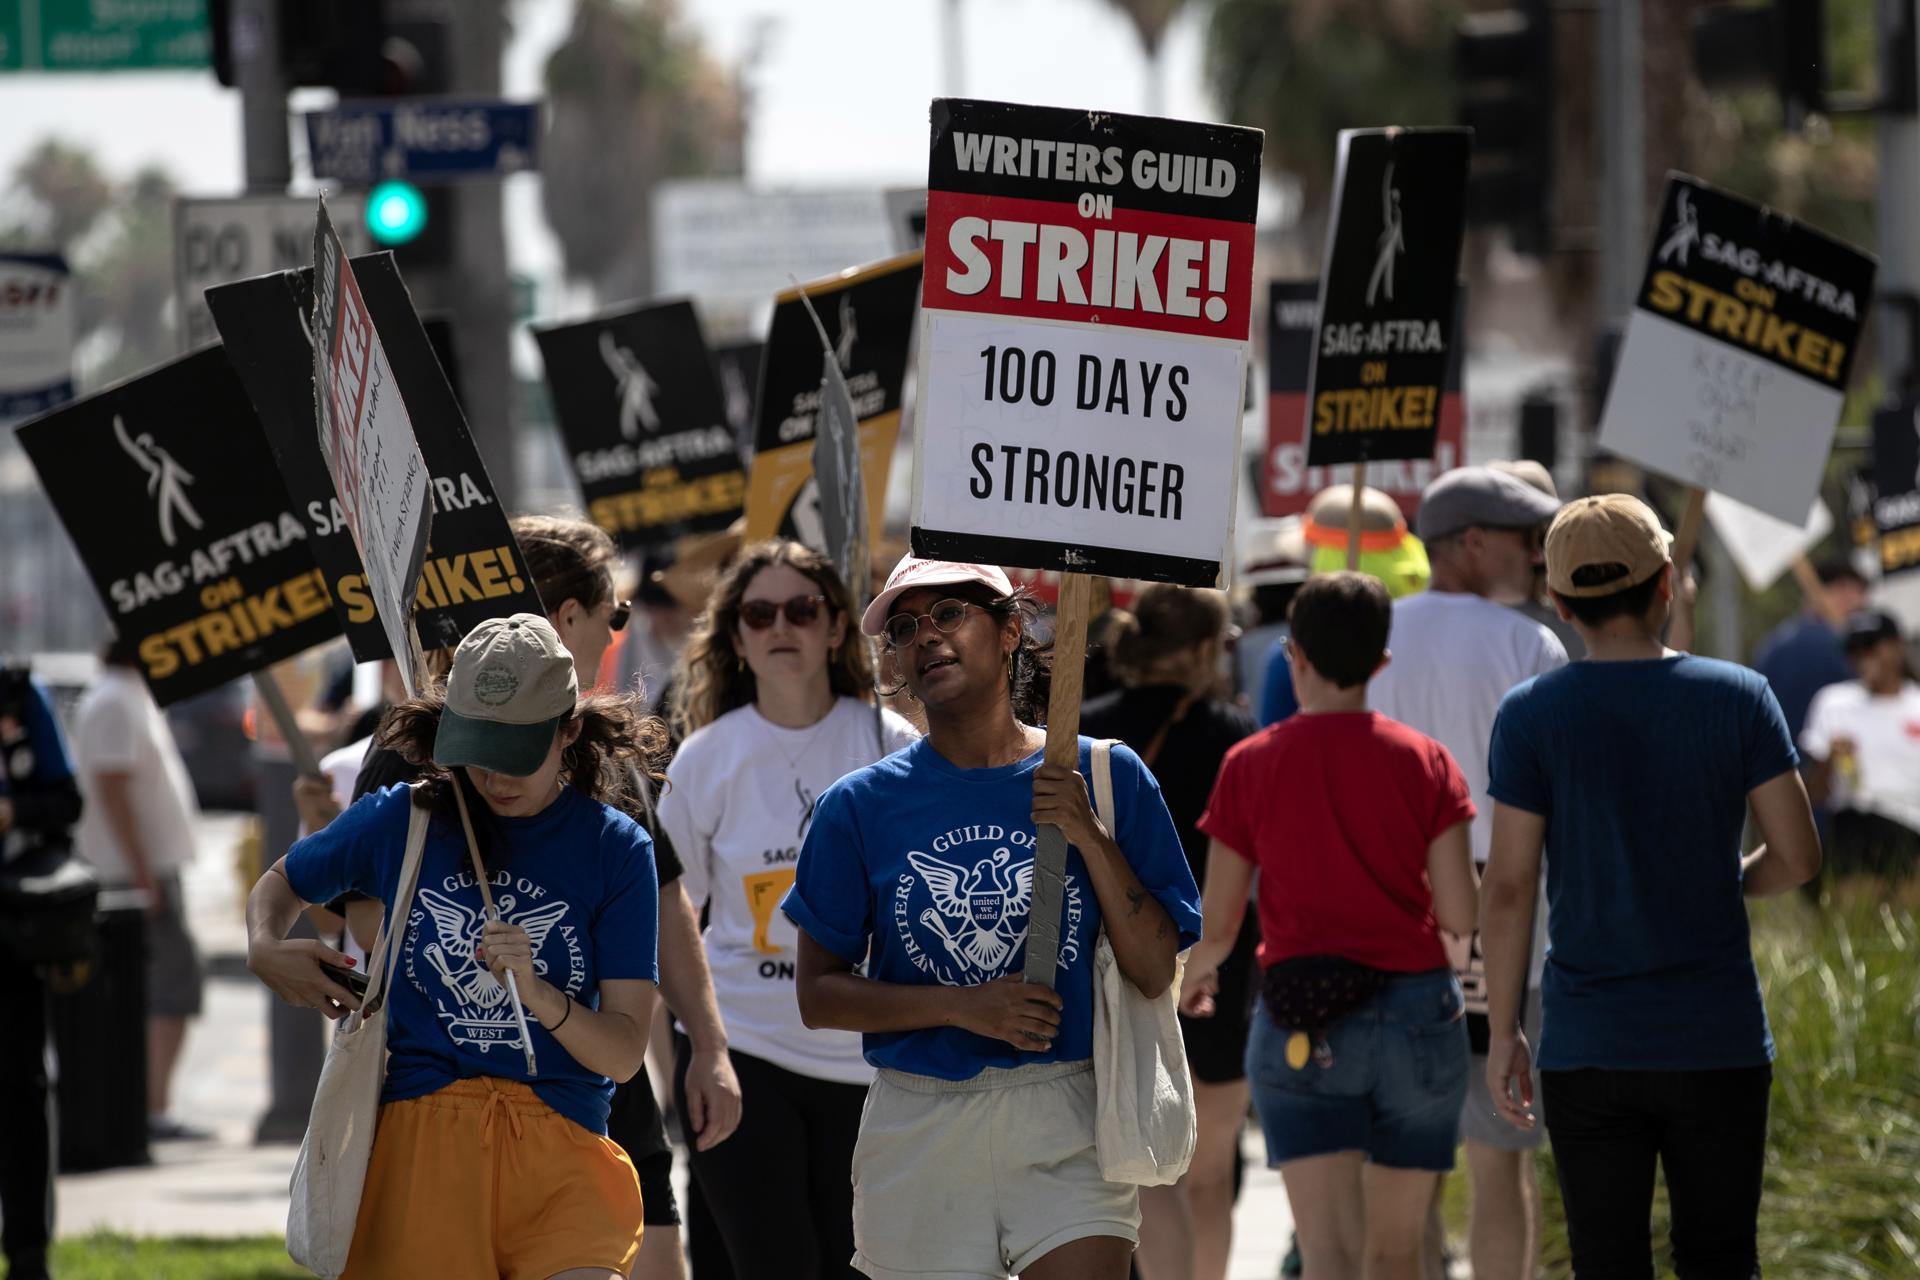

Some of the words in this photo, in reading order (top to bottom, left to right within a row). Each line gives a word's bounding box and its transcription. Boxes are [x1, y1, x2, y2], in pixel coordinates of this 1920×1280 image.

[394, 106, 493, 150] Ness
[953, 131, 1123, 185] WRITERS
[1131, 149, 1236, 197] GUILD
[1077, 193, 1113, 219] ON
[183, 223, 249, 275] DO
[946, 216, 1229, 323] STRIKE!
[321, 233, 336, 328] GUILD
[1735, 277, 1776, 307] ON
[1650, 270, 1846, 380] STRIKE!
[367, 349, 384, 429] WANT
[980, 345, 1056, 406] 100
[1076, 354, 1189, 422] DAYS
[1361, 361, 1387, 384] ON
[1314, 386, 1437, 434] STRIKE!
[970, 443, 1184, 520] STRONGER
[201, 576, 243, 609] ON
[337, 547, 525, 623] SRIKE!
[894, 873, 928, 973] WRITERS
[932, 825, 1004, 853] GUILD
[973, 896, 1000, 906] united
[975, 912, 998, 920] stand
[443, 870, 511, 893] GULD
[516, 878, 547, 900] OF
[559, 925, 585, 999] AMERI
[759, 961, 794, 980] ON
[466, 1028, 505, 1039] WEST
